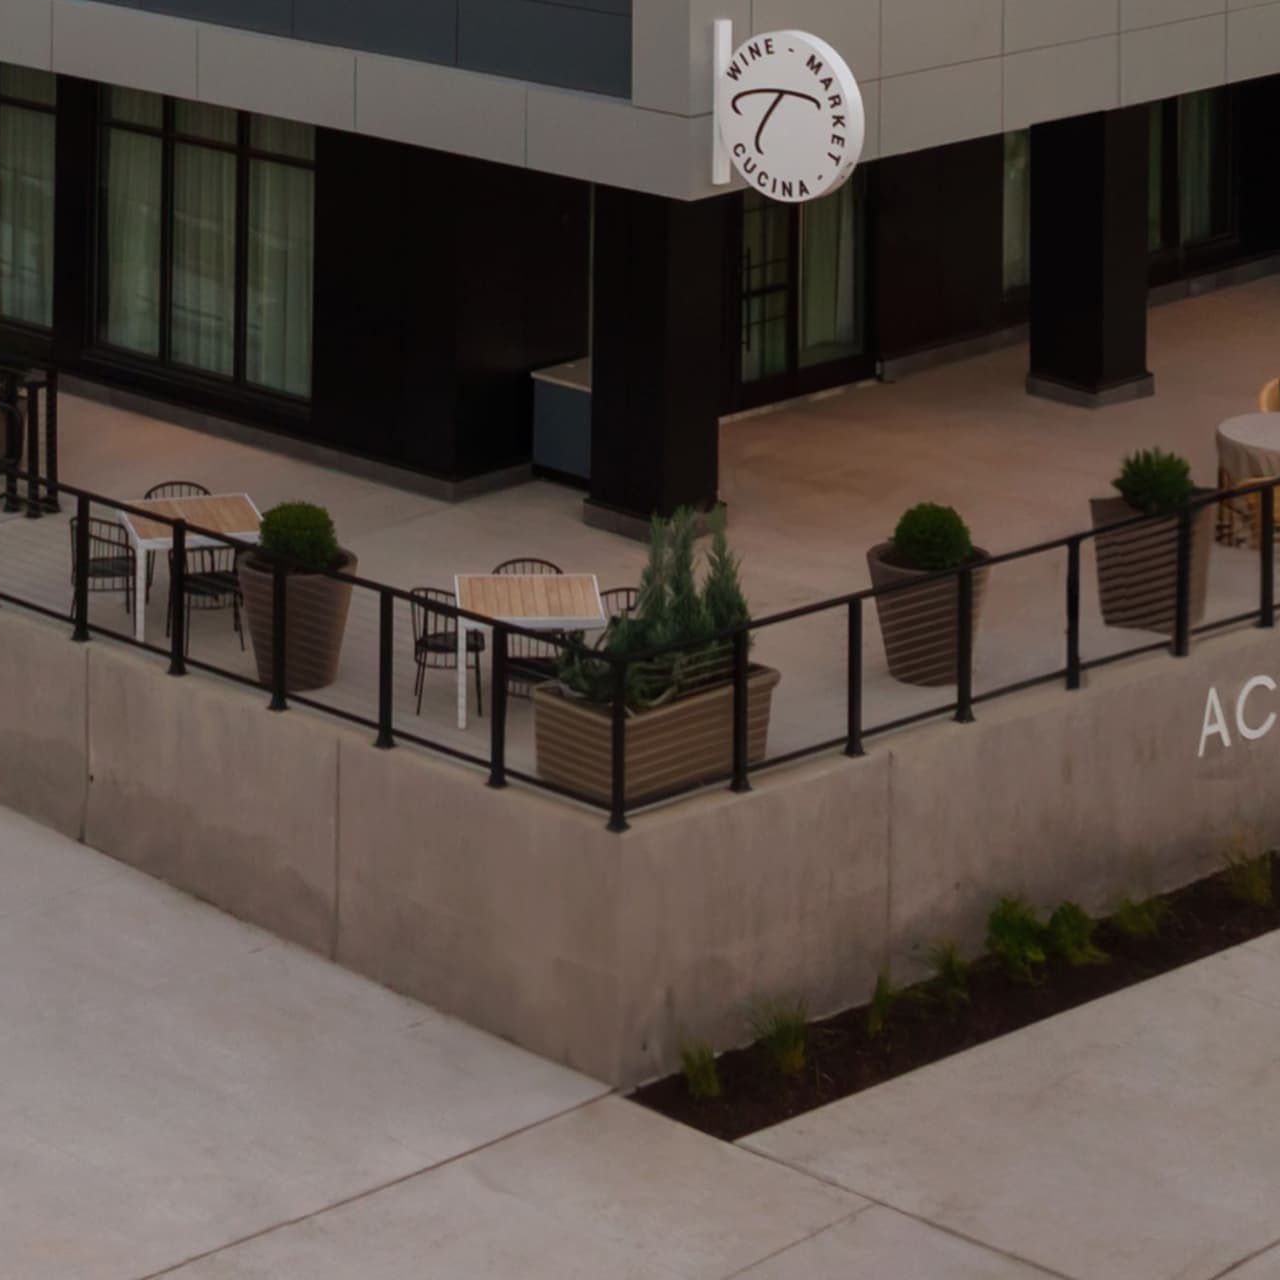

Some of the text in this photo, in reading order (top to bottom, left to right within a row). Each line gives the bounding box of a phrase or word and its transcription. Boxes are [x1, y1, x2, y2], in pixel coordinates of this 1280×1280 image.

[726, 38, 846, 198] WINE MARKET CUCINA
[1197, 674, 1277, 757] AC
